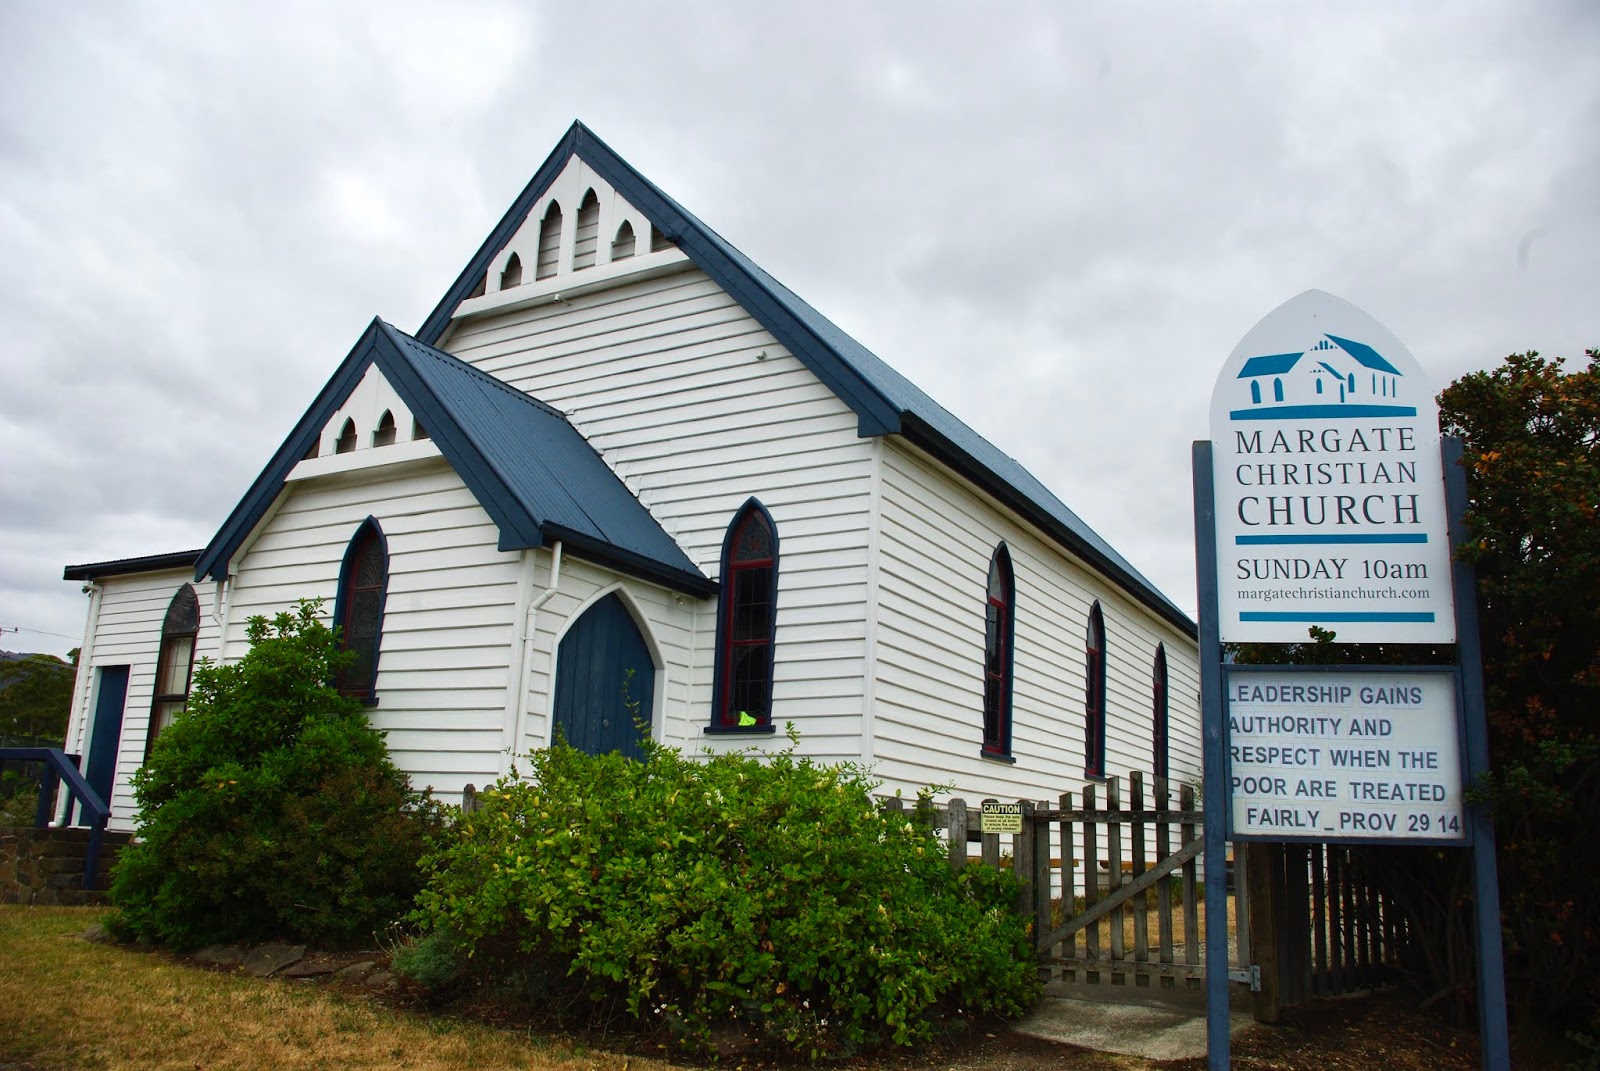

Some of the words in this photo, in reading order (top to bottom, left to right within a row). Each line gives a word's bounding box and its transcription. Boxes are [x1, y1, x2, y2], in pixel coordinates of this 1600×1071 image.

[1235, 427, 1416, 454] MARGATE
[1236, 461, 1416, 486] CHRISTIAN
[1237, 494, 1421, 526] CHURCH
[1237, 558, 1349, 580] SUNDAY
[1362, 559, 1429, 579] 10am
[1237, 586, 1430, 602] margatechristianchurch.com
[1359, 686, 1422, 705] GAINS
[1229, 715, 1342, 735] AUTHORITY
[1349, 718, 1392, 736] AND
[1231, 745, 1320, 766] RESPECT
[1330, 749, 1390, 768] WHEN
[1398, 751, 1438, 769] THE
[1232, 776, 1287, 795] POOR
[1295, 779, 1337, 798] ARE
[1350, 781, 1446, 802] TREATED
[984, 805, 1020, 814] CAUTION
[1247, 808, 1320, 828] FAIRLY
[1340, 811, 1397, 831] PROV
[1408, 813, 1430, 832] 29
[1438, 815, 1460, 833] 14
